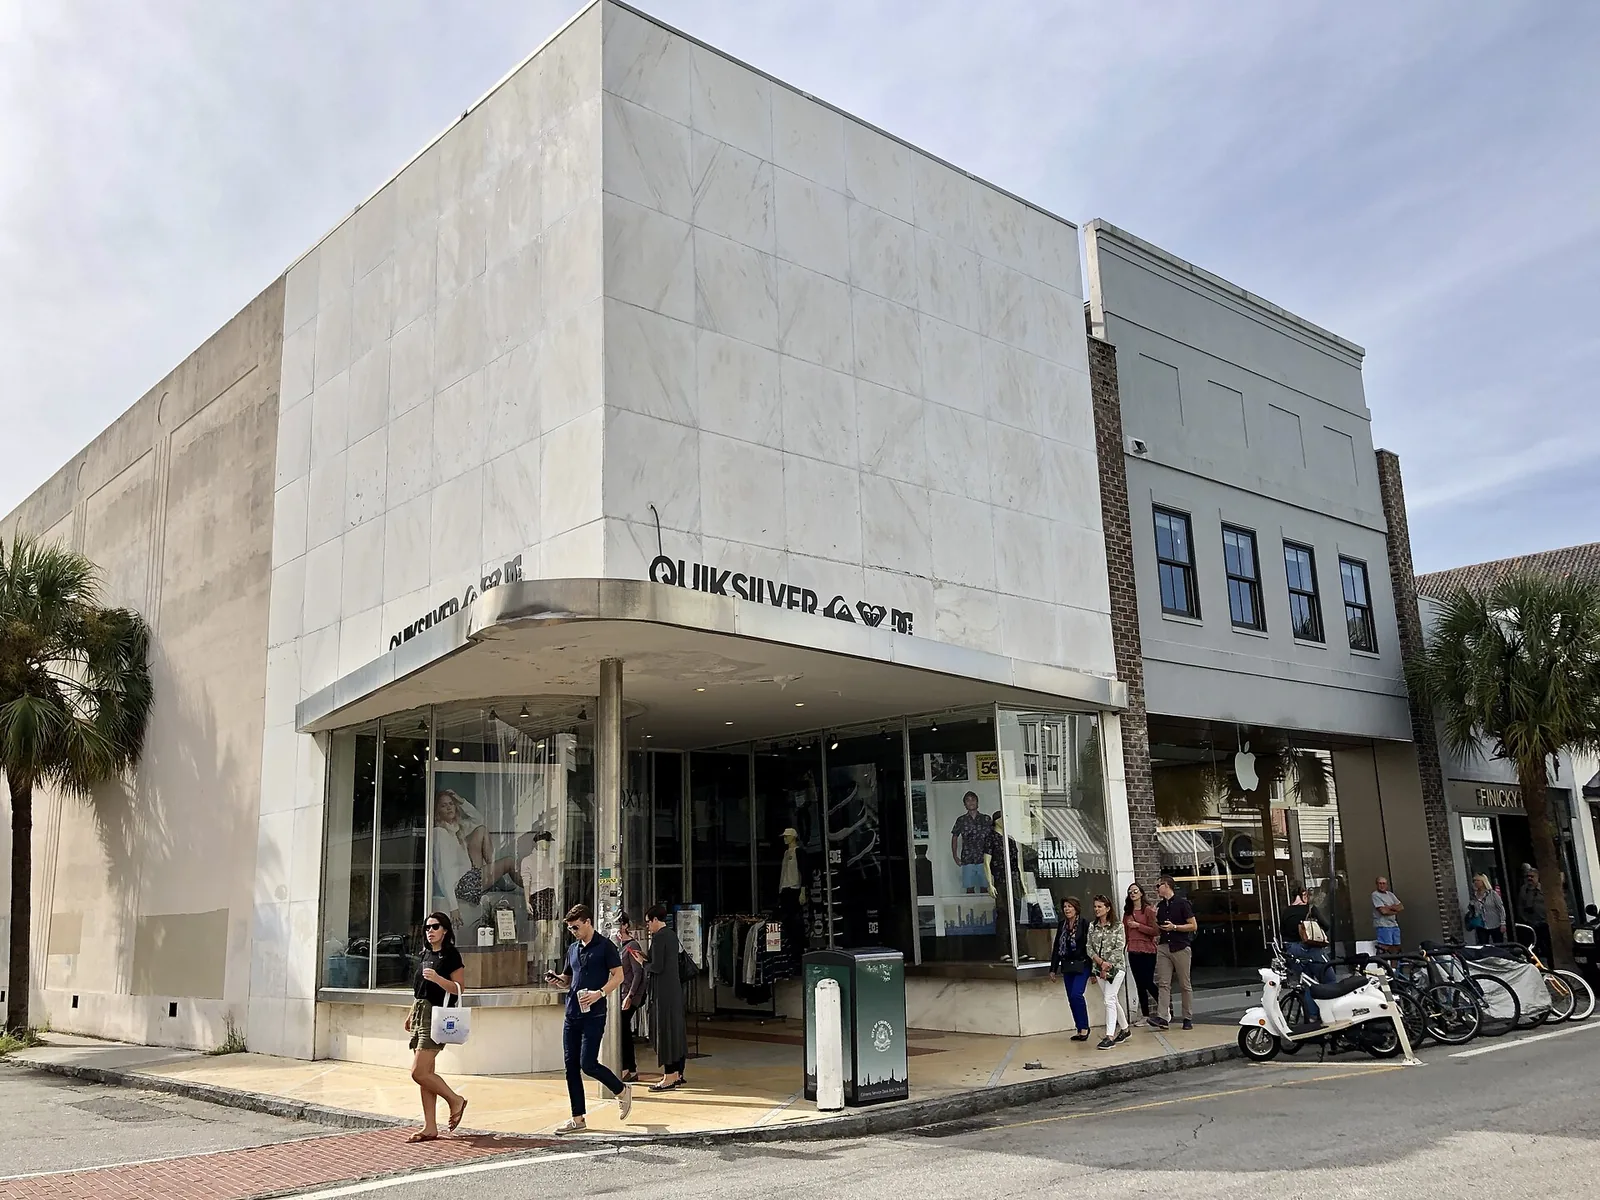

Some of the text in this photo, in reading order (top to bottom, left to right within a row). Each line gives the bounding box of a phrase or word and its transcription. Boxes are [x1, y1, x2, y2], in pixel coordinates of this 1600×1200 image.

[649, 555, 818, 615] QUIKSILVER
[1480, 788, 1518, 808] FINICKY
[1038, 847, 1078, 858] STRANGE
[1038, 859, 1079, 871] PATTERNS
[766, 924, 782, 934] SALE
